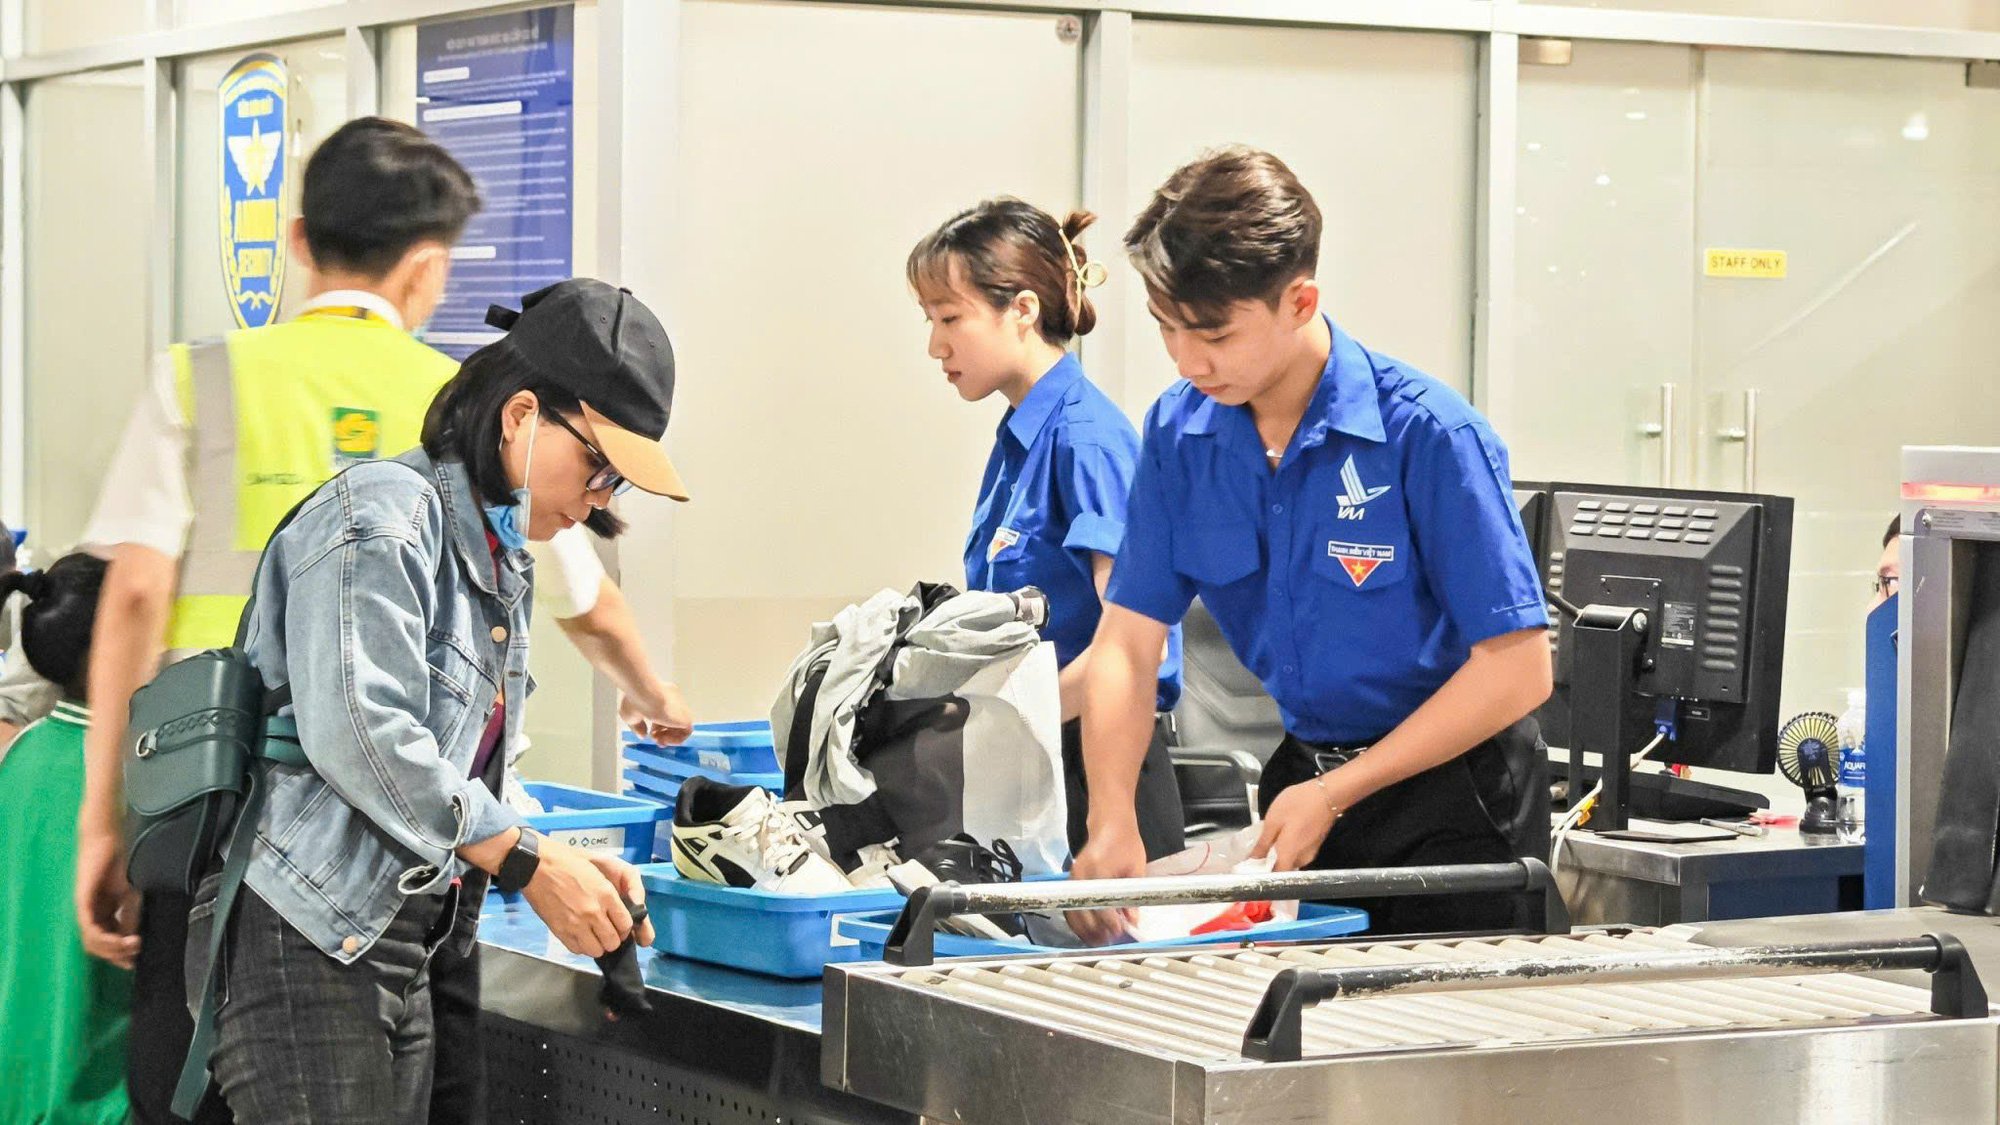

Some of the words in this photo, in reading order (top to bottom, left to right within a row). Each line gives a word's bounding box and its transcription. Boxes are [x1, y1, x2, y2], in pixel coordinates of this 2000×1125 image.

[1711, 255, 1746, 268] STAFF
[1751, 257, 1780, 269] ONLY
[591, 837, 609, 846] CMC
